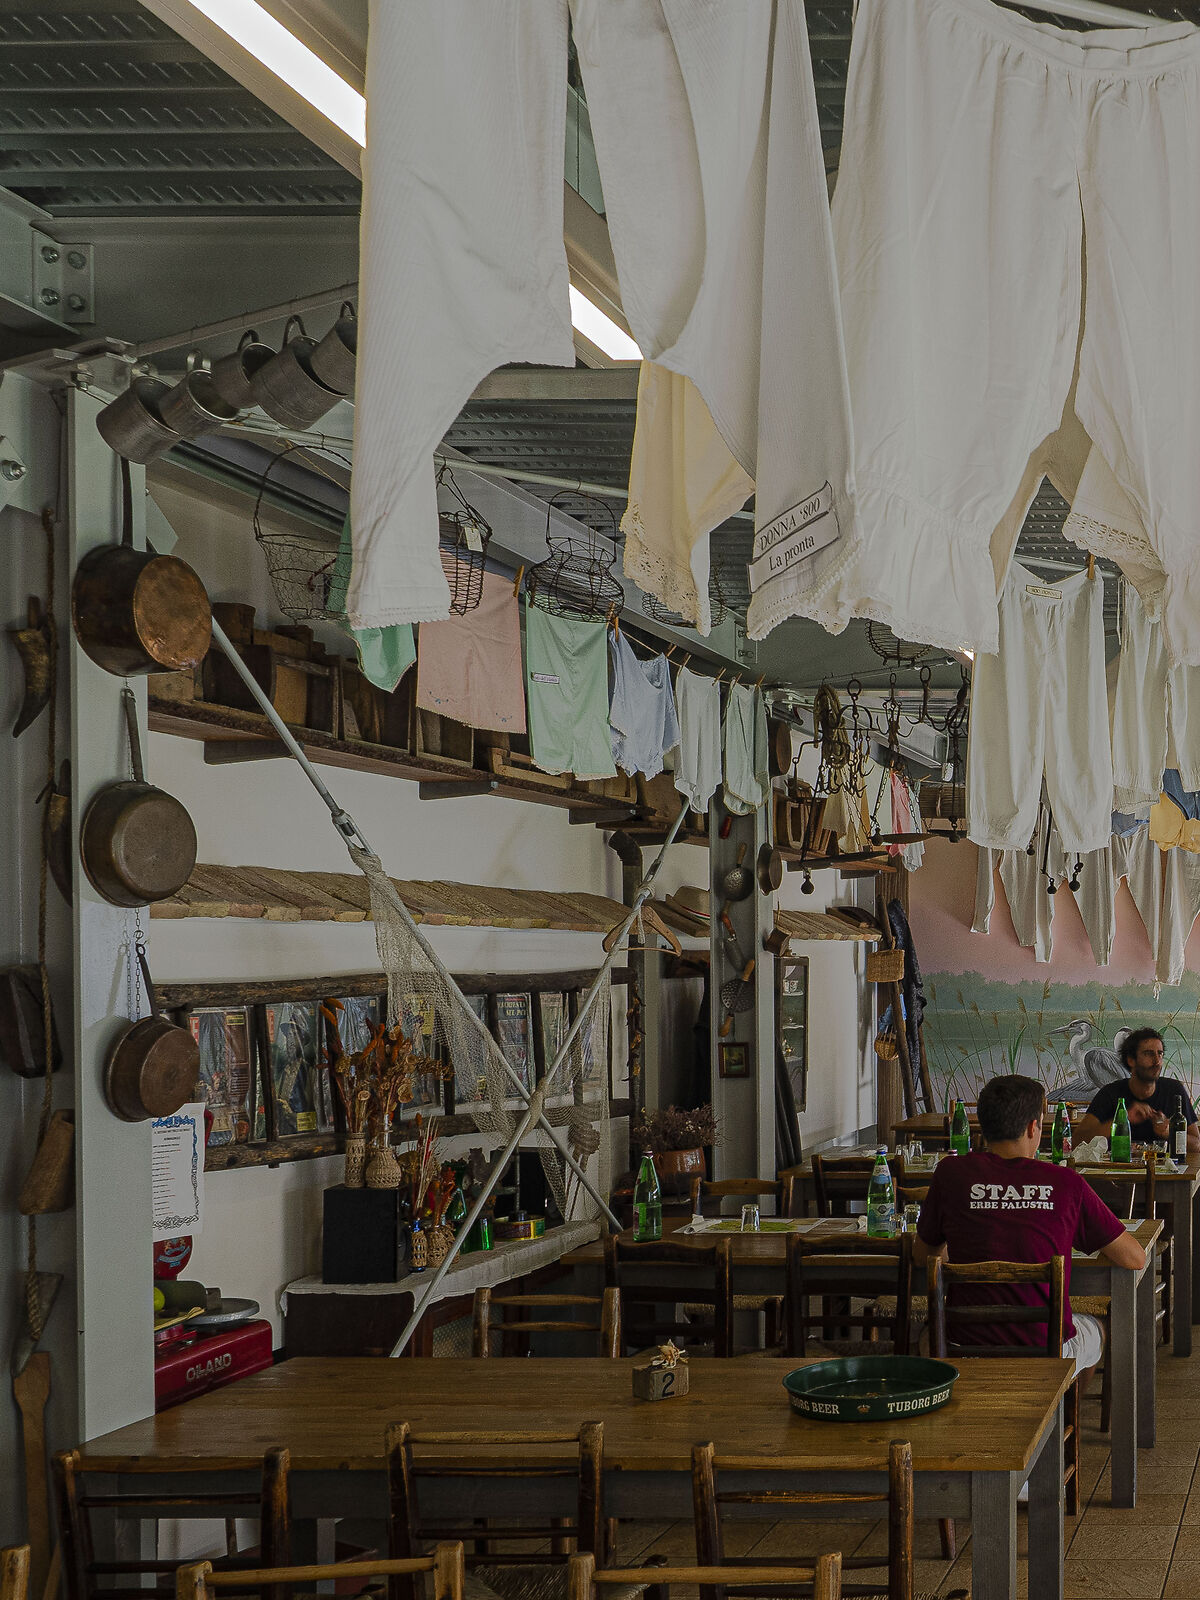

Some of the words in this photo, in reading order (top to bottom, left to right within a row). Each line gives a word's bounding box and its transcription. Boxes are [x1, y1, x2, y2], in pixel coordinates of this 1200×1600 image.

[760, 514, 797, 551] DONNA
[768, 556, 783, 571] La
[784, 535, 815, 567] pronta
[970, 1183, 1054, 1200] STAFF
[969, 1201, 998, 1210] ERBE
[1001, 1201, 1054, 1210] PALUSTRI
[662, 1371, 675, 1398] 2
[811, 1401, 840, 1415] BEER
[887, 1396, 931, 1413] TUBORG
[931, 1388, 951, 1406] BEER
